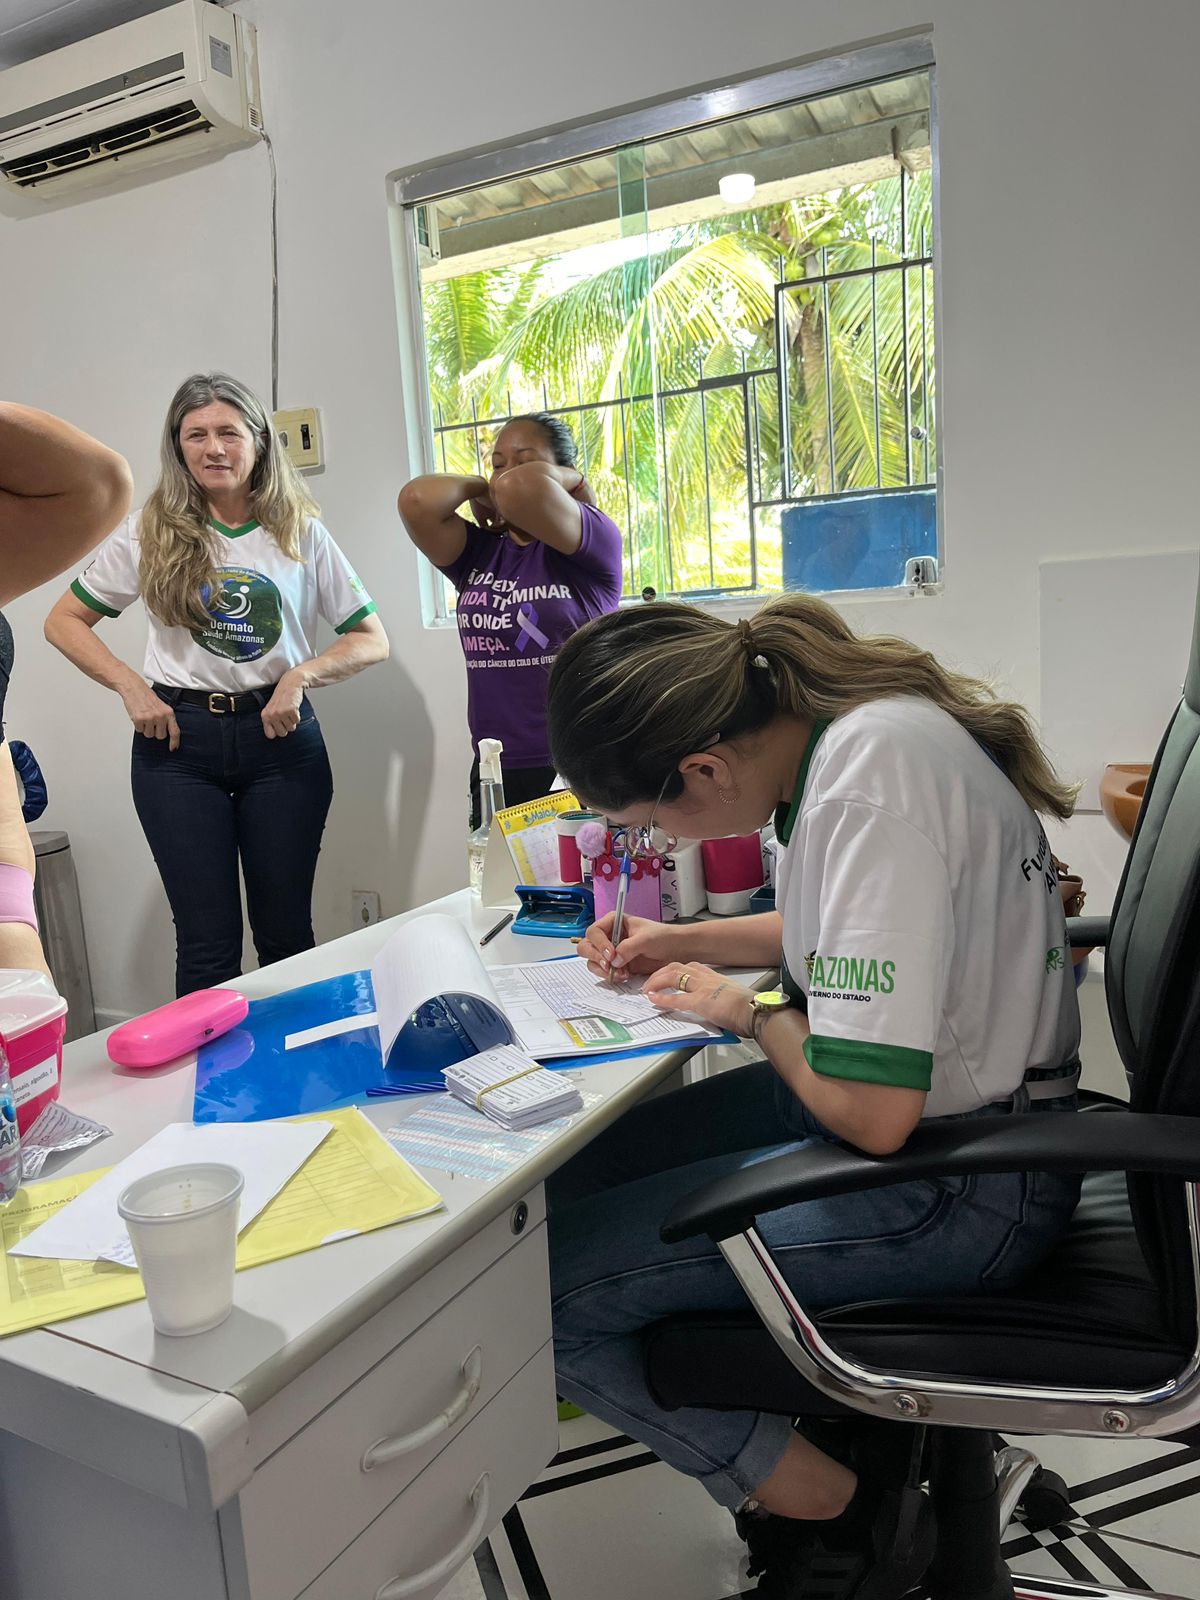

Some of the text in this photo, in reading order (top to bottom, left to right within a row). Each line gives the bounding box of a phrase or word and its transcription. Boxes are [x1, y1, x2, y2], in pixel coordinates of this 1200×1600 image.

[483, 571, 520, 593] DEIX
[492, 585, 572, 611] TMINAR
[472, 612, 513, 630] ONDE
[225, 630, 265, 644] Amazonas
[813, 956, 895, 993] AZONAS
[808, 991, 871, 1003] VERNO DO ESTADO
